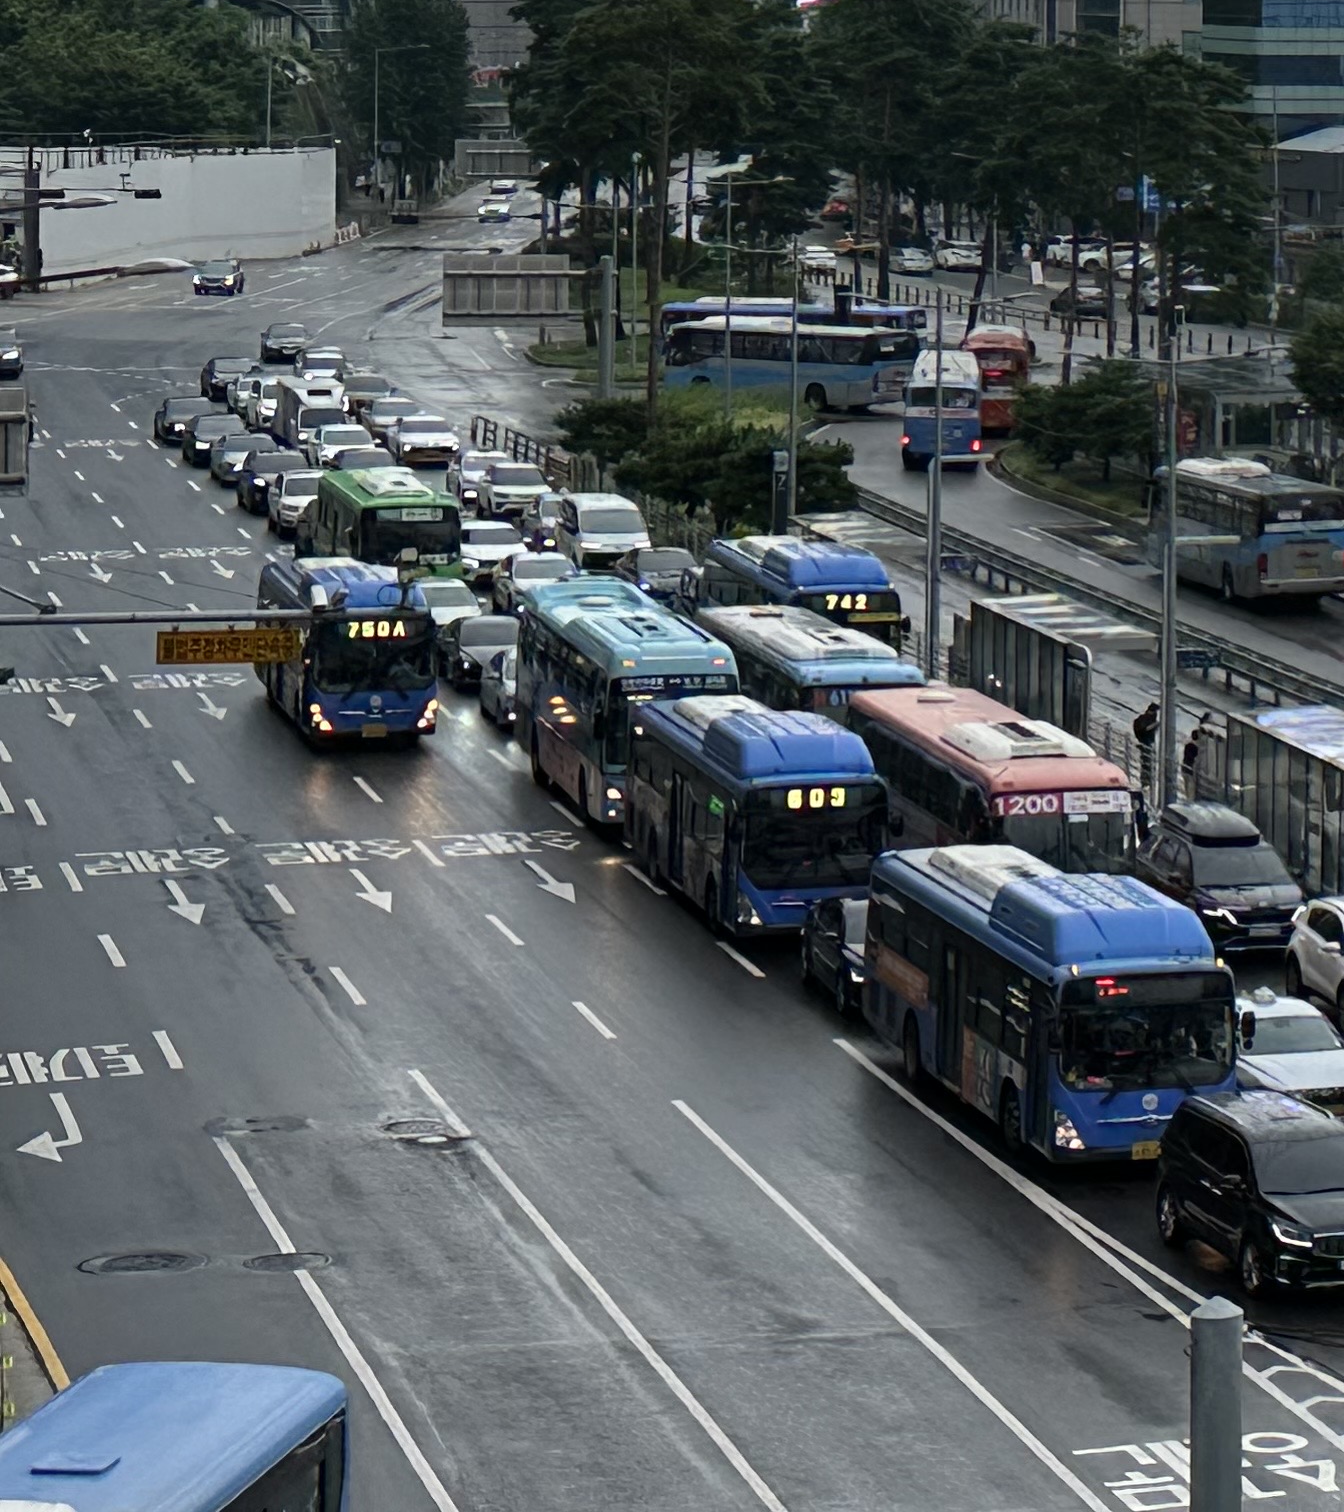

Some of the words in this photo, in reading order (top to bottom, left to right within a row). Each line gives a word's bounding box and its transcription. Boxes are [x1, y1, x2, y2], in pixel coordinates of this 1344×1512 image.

[825, 594, 867, 610] 742
[994, 794, 1058, 816] 1200
[75, 847, 230, 876] 숭례문
[0, 1043, 144, 1085] 퇴계
